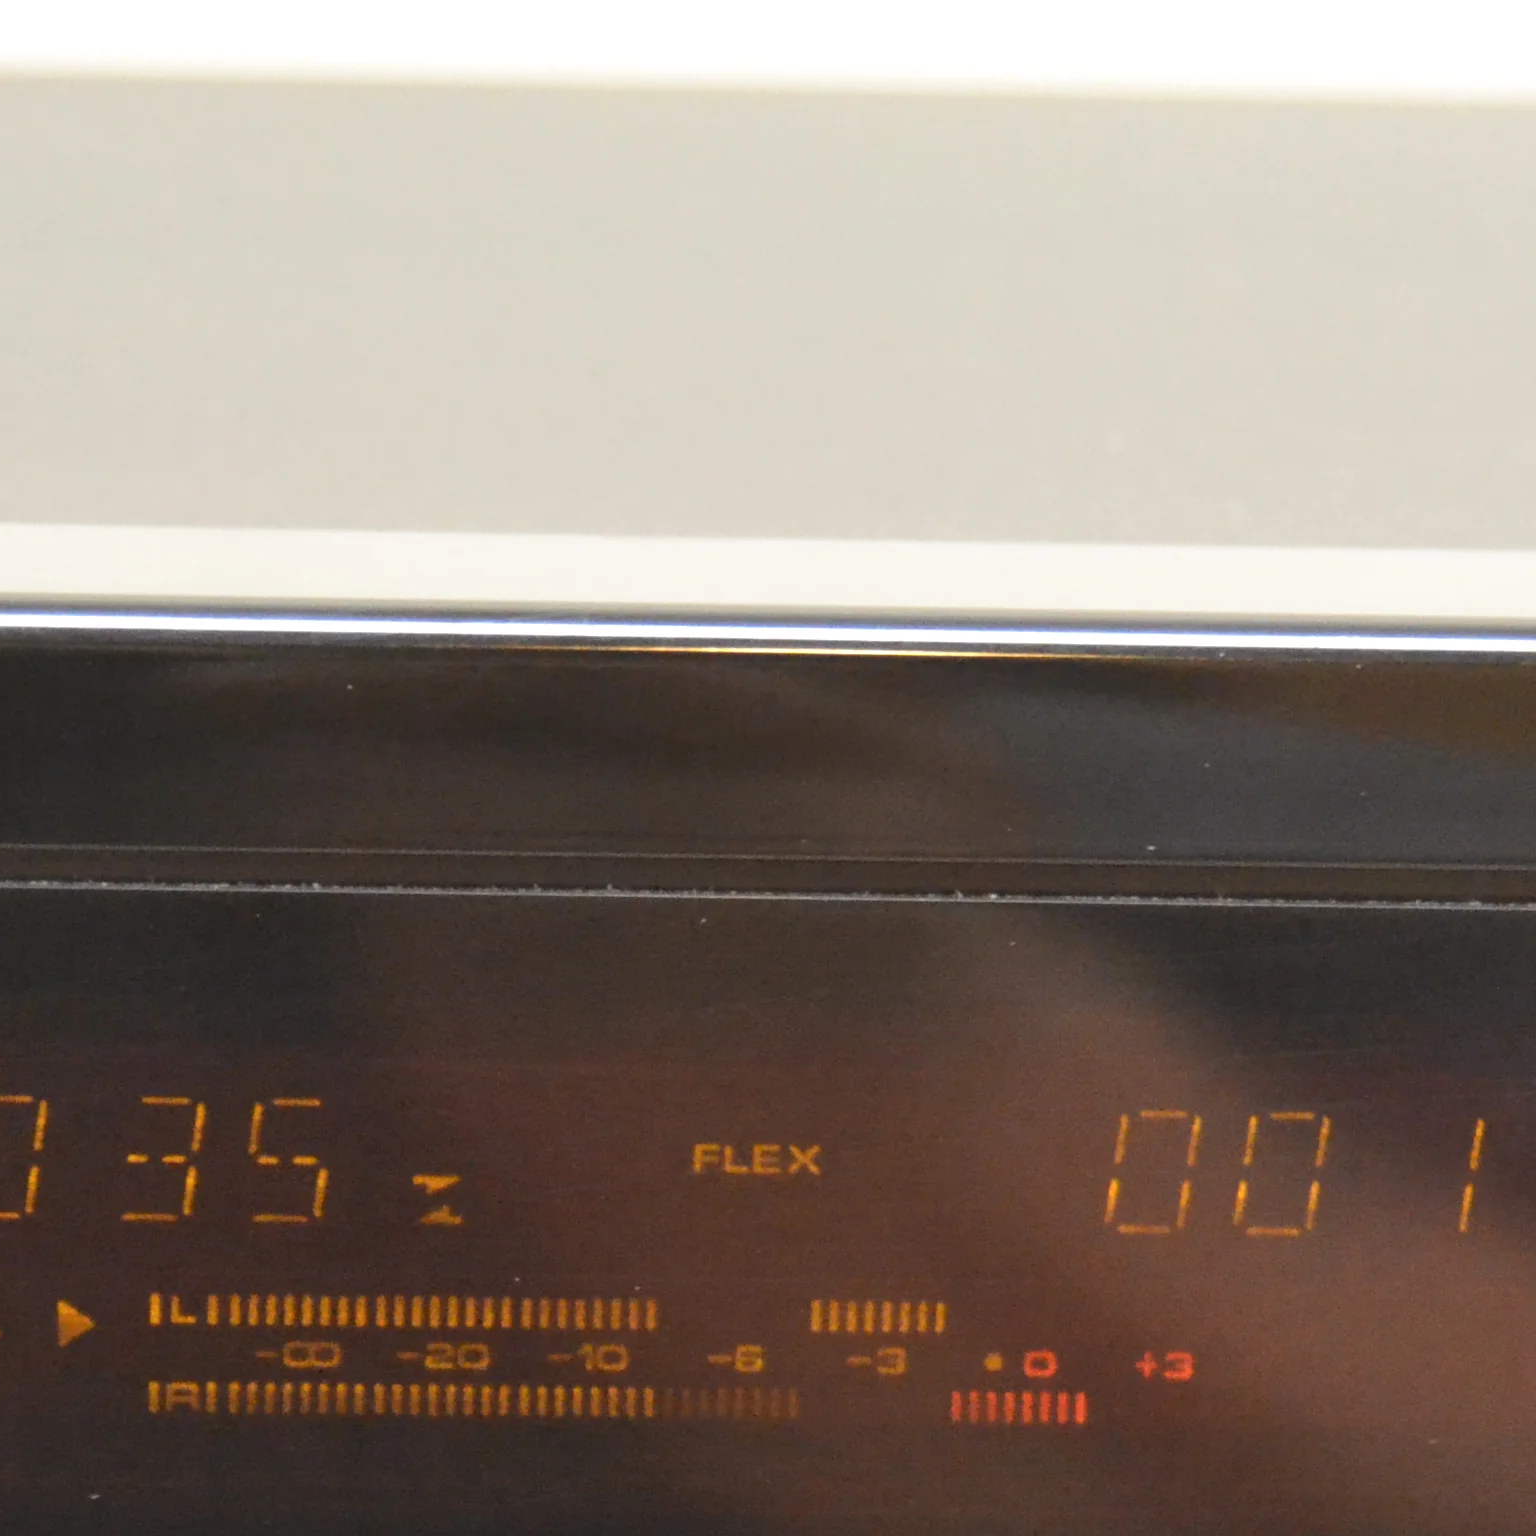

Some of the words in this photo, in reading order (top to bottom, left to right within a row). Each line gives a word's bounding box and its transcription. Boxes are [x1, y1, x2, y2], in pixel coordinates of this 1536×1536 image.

[692, 1142, 824, 1175] FLEX
[396, 1342, 491, 1371] -20
[547, 1343, 630, 1372] -10
[707, 1344, 765, 1373] -6
[846, 1346, 908, 1376] -3
[1135, 1351, 1195, 1381] +3
